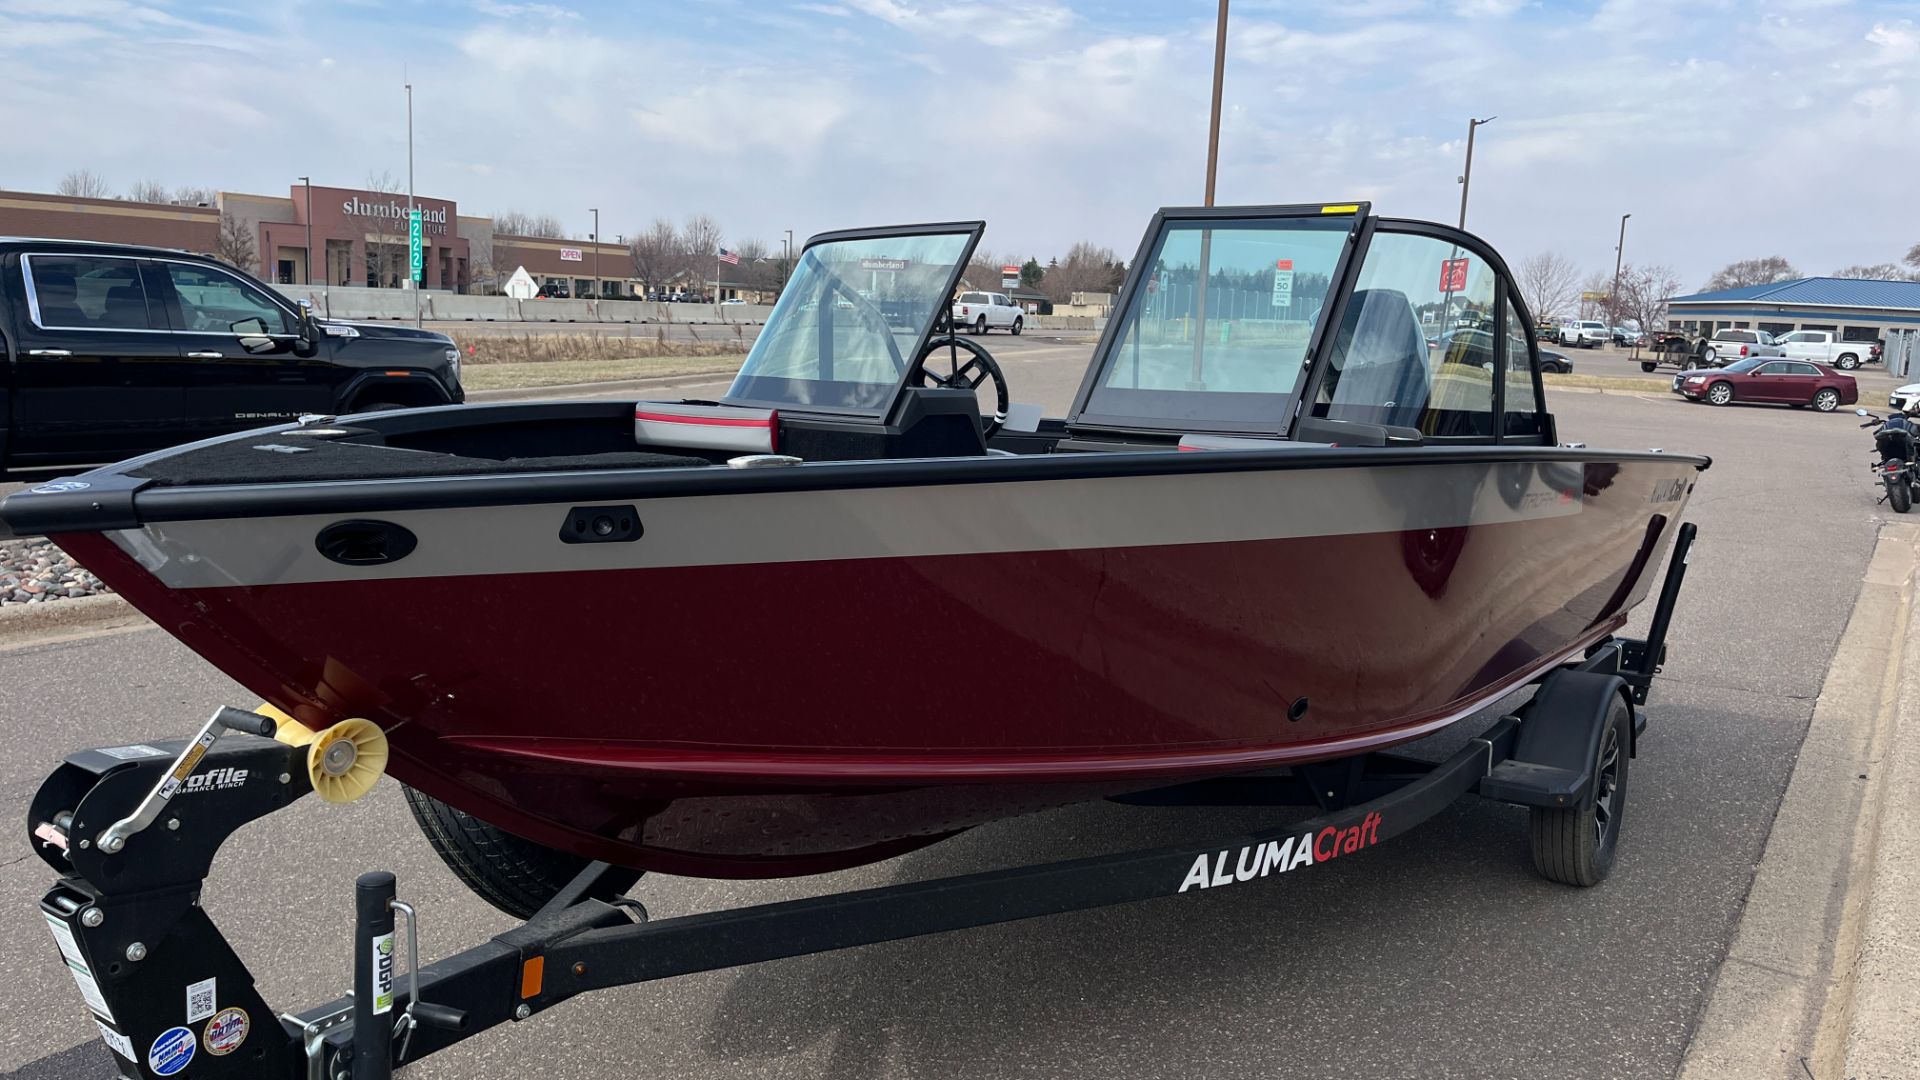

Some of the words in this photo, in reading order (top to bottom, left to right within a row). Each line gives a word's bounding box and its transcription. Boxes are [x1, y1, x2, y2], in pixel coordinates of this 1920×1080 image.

[343, 197, 446, 223] slumbeland
[394, 221, 447, 235] FUITURE
[561, 249, 581, 260] OPEN
[1276, 282, 1289, 290] 50
[182, 767, 249, 788] ofile
[218, 781, 244, 789] WINCH
[1177, 811, 1383, 894] ALUMACraft
[379, 955, 394, 994] DGP
